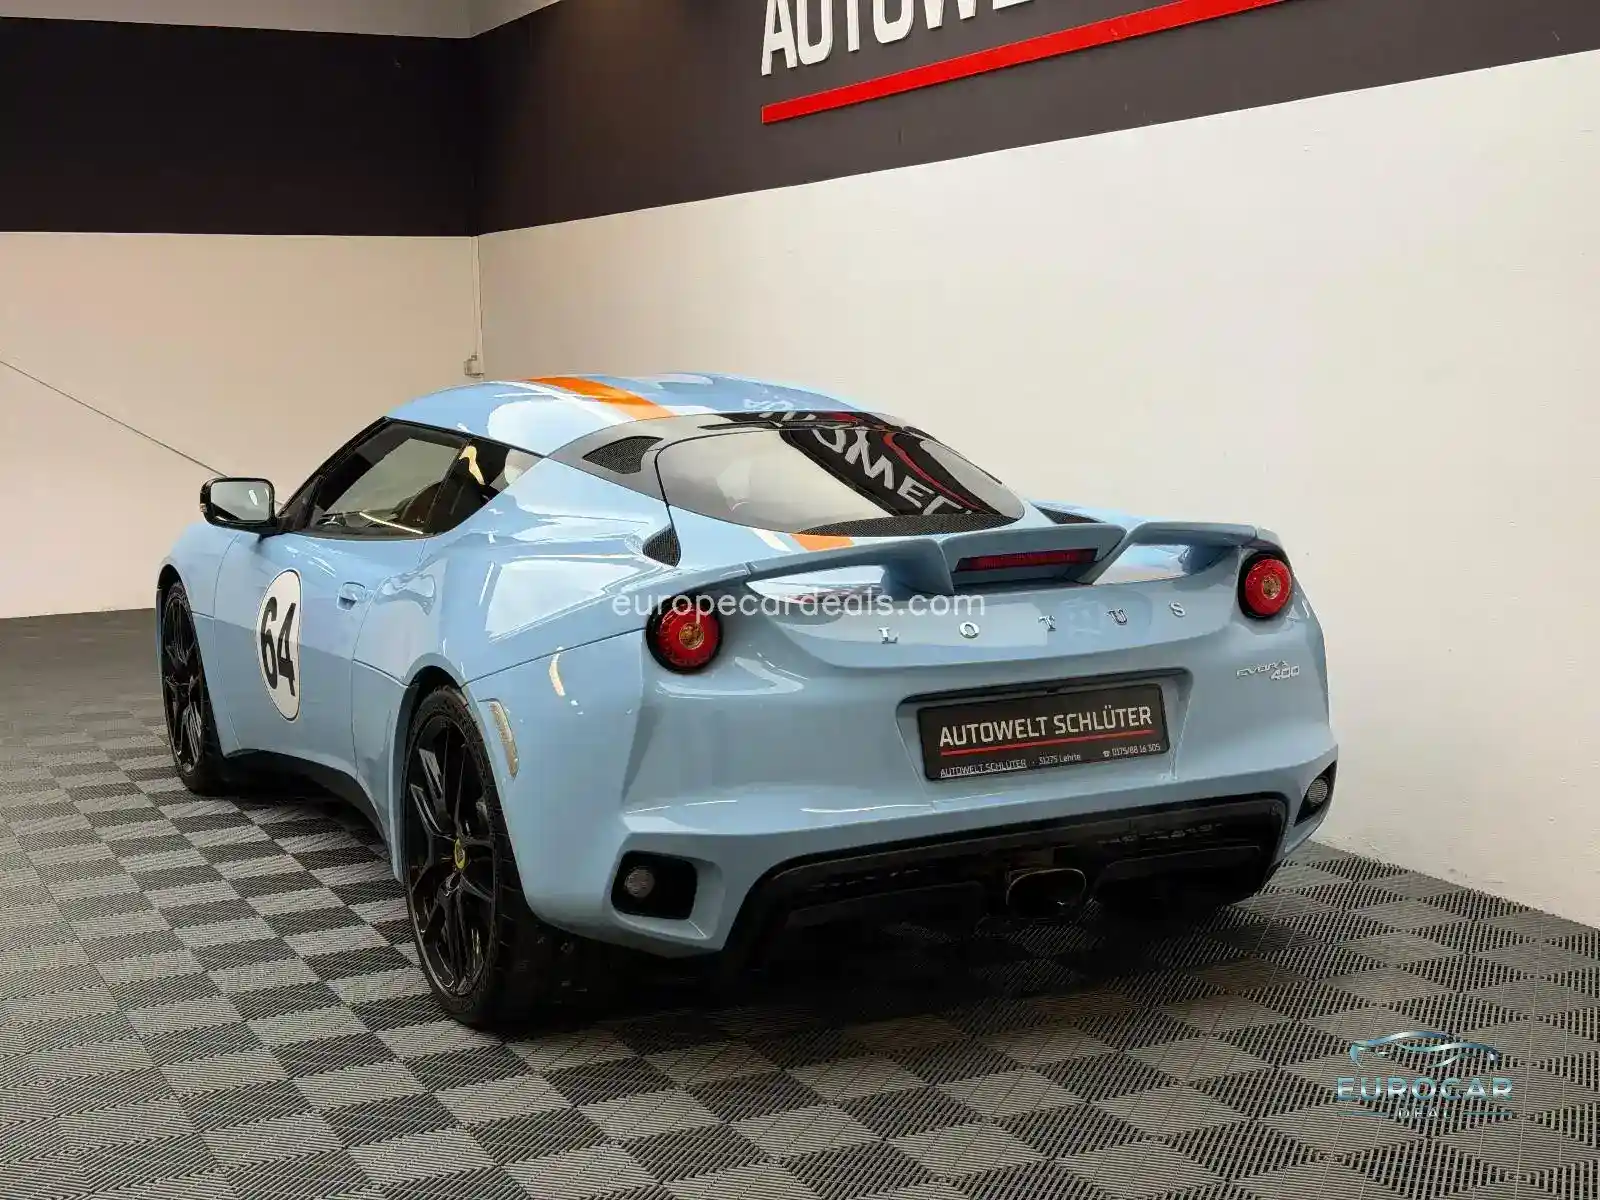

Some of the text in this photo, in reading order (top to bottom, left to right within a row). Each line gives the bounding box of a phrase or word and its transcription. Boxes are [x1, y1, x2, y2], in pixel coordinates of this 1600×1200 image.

[260, 597, 296, 697] 64
[1270, 665, 1300, 680] 400
[940, 704, 1153, 747] AUTOWELT SCHLÜTER
